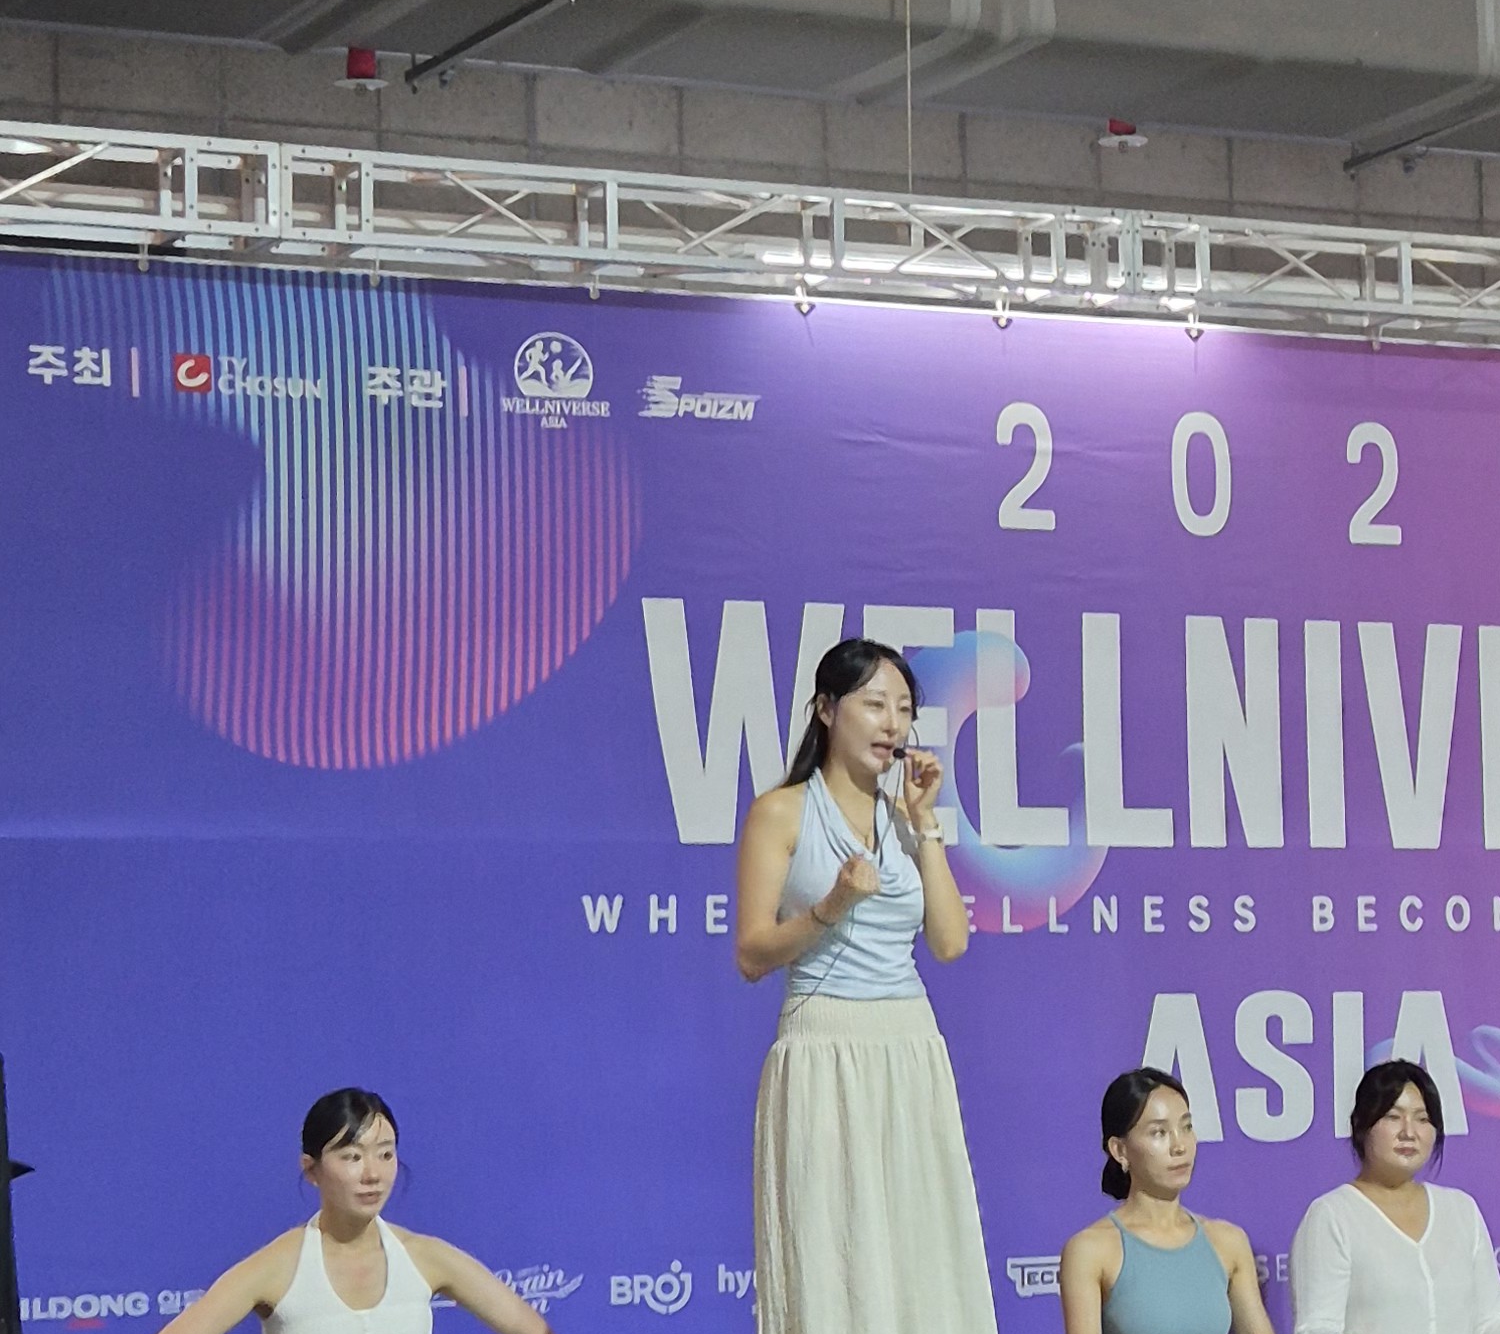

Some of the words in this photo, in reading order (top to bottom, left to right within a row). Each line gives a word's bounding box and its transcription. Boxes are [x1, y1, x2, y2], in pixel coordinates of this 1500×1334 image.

[28, 345, 111, 387] 주최
[217, 373, 324, 398] CHOSUN
[367, 367, 447, 408] 주관
[502, 396, 611, 417] WELLNIVERSE
[582, 893, 729, 935] WHE
[961, 894, 1257, 935] LLNESS
[1139, 989, 1470, 1142] ASIA
[19, 1291, 150, 1322] ILDONG
